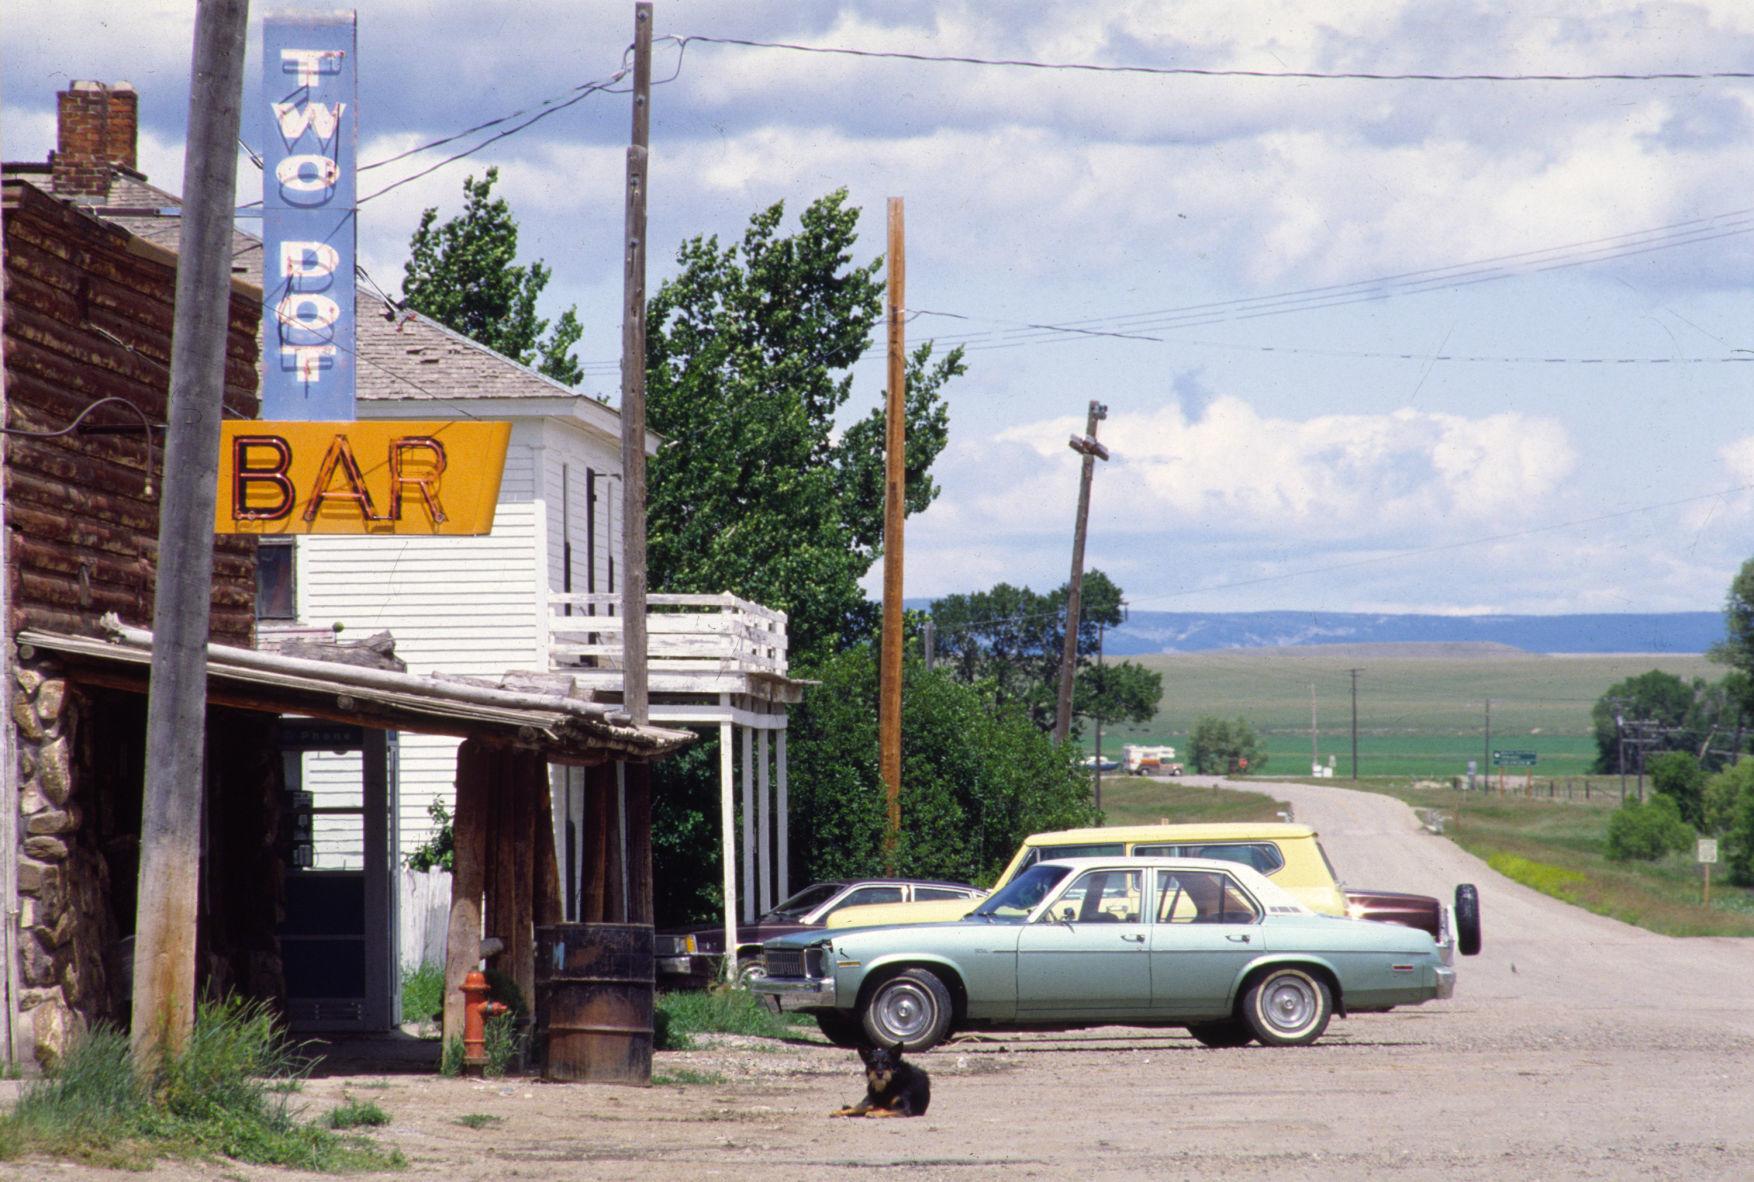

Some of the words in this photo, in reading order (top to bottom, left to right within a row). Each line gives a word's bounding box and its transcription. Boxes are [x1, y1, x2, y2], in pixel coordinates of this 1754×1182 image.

[271, 48, 346, 192] TWO
[274, 241, 341, 384] DOT
[231, 434, 448, 522] BAR
